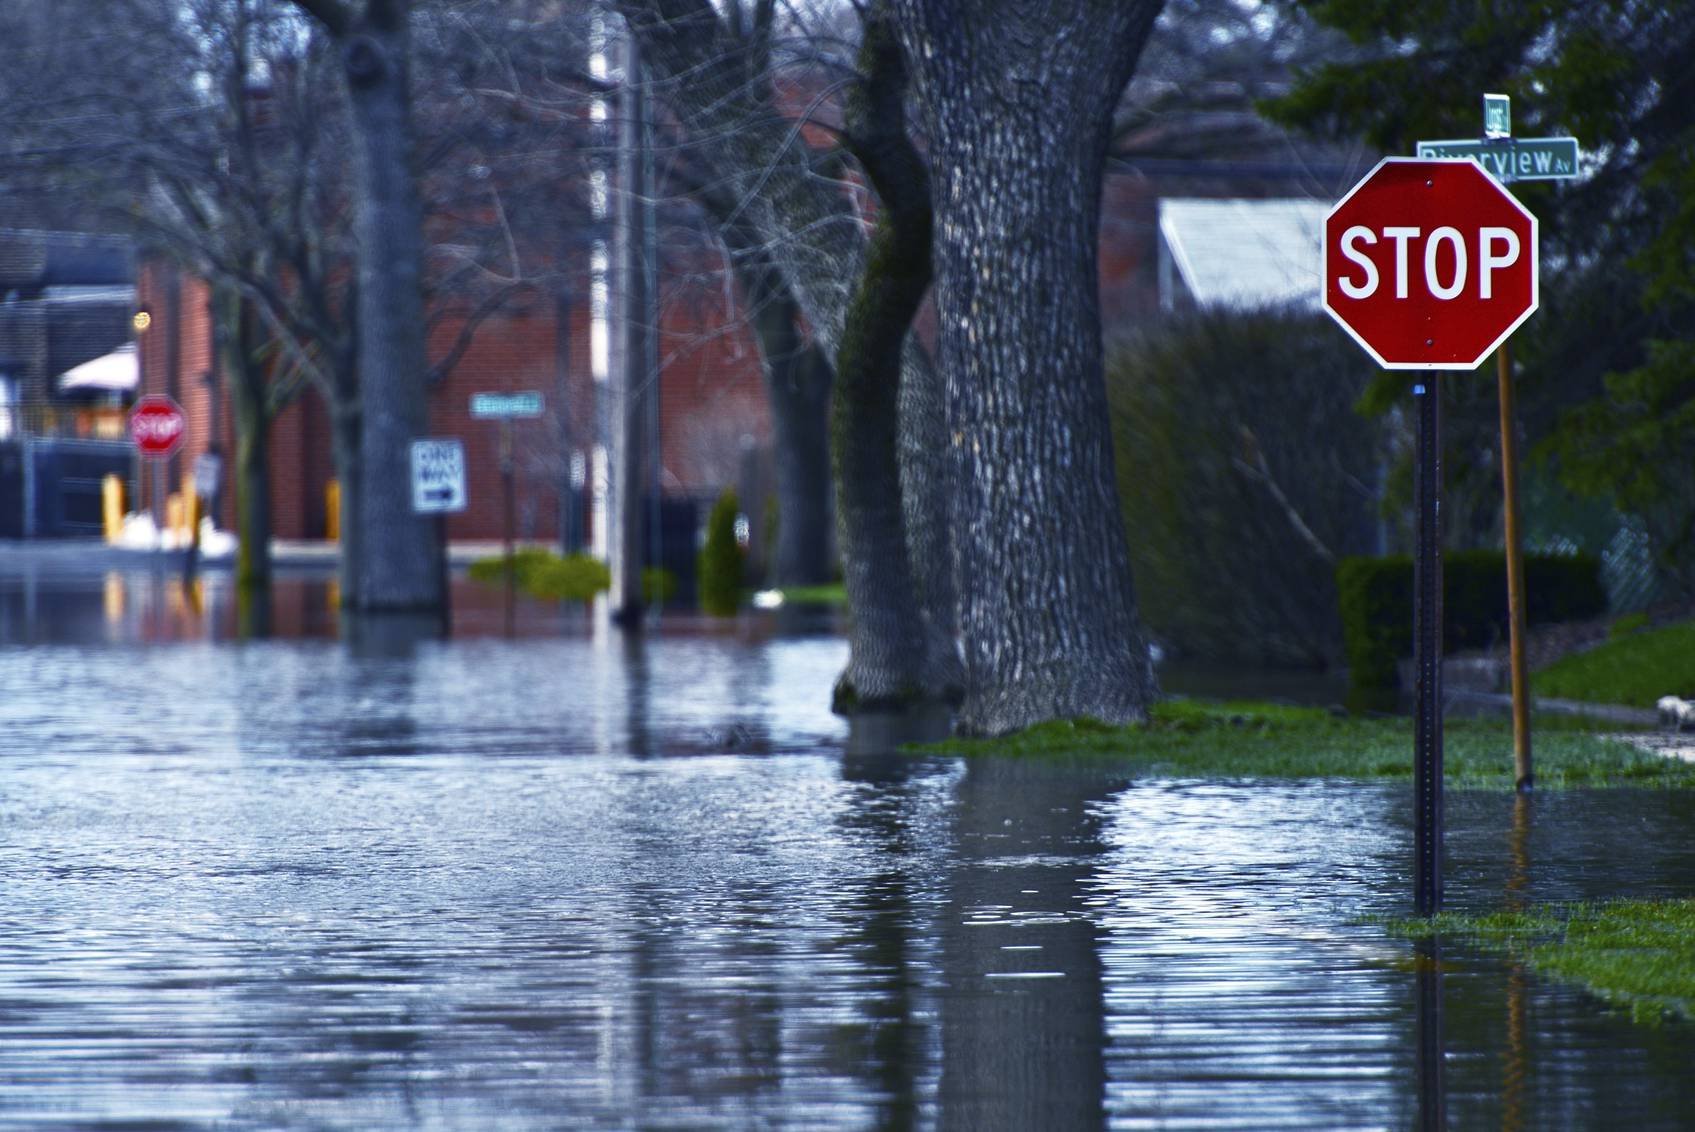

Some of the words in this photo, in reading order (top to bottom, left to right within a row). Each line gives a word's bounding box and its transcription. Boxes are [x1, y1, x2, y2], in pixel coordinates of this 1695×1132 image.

[1421, 147, 1553, 174] rview
[1338, 225, 1520, 300] STOP
[133, 413, 182, 440] STOP
